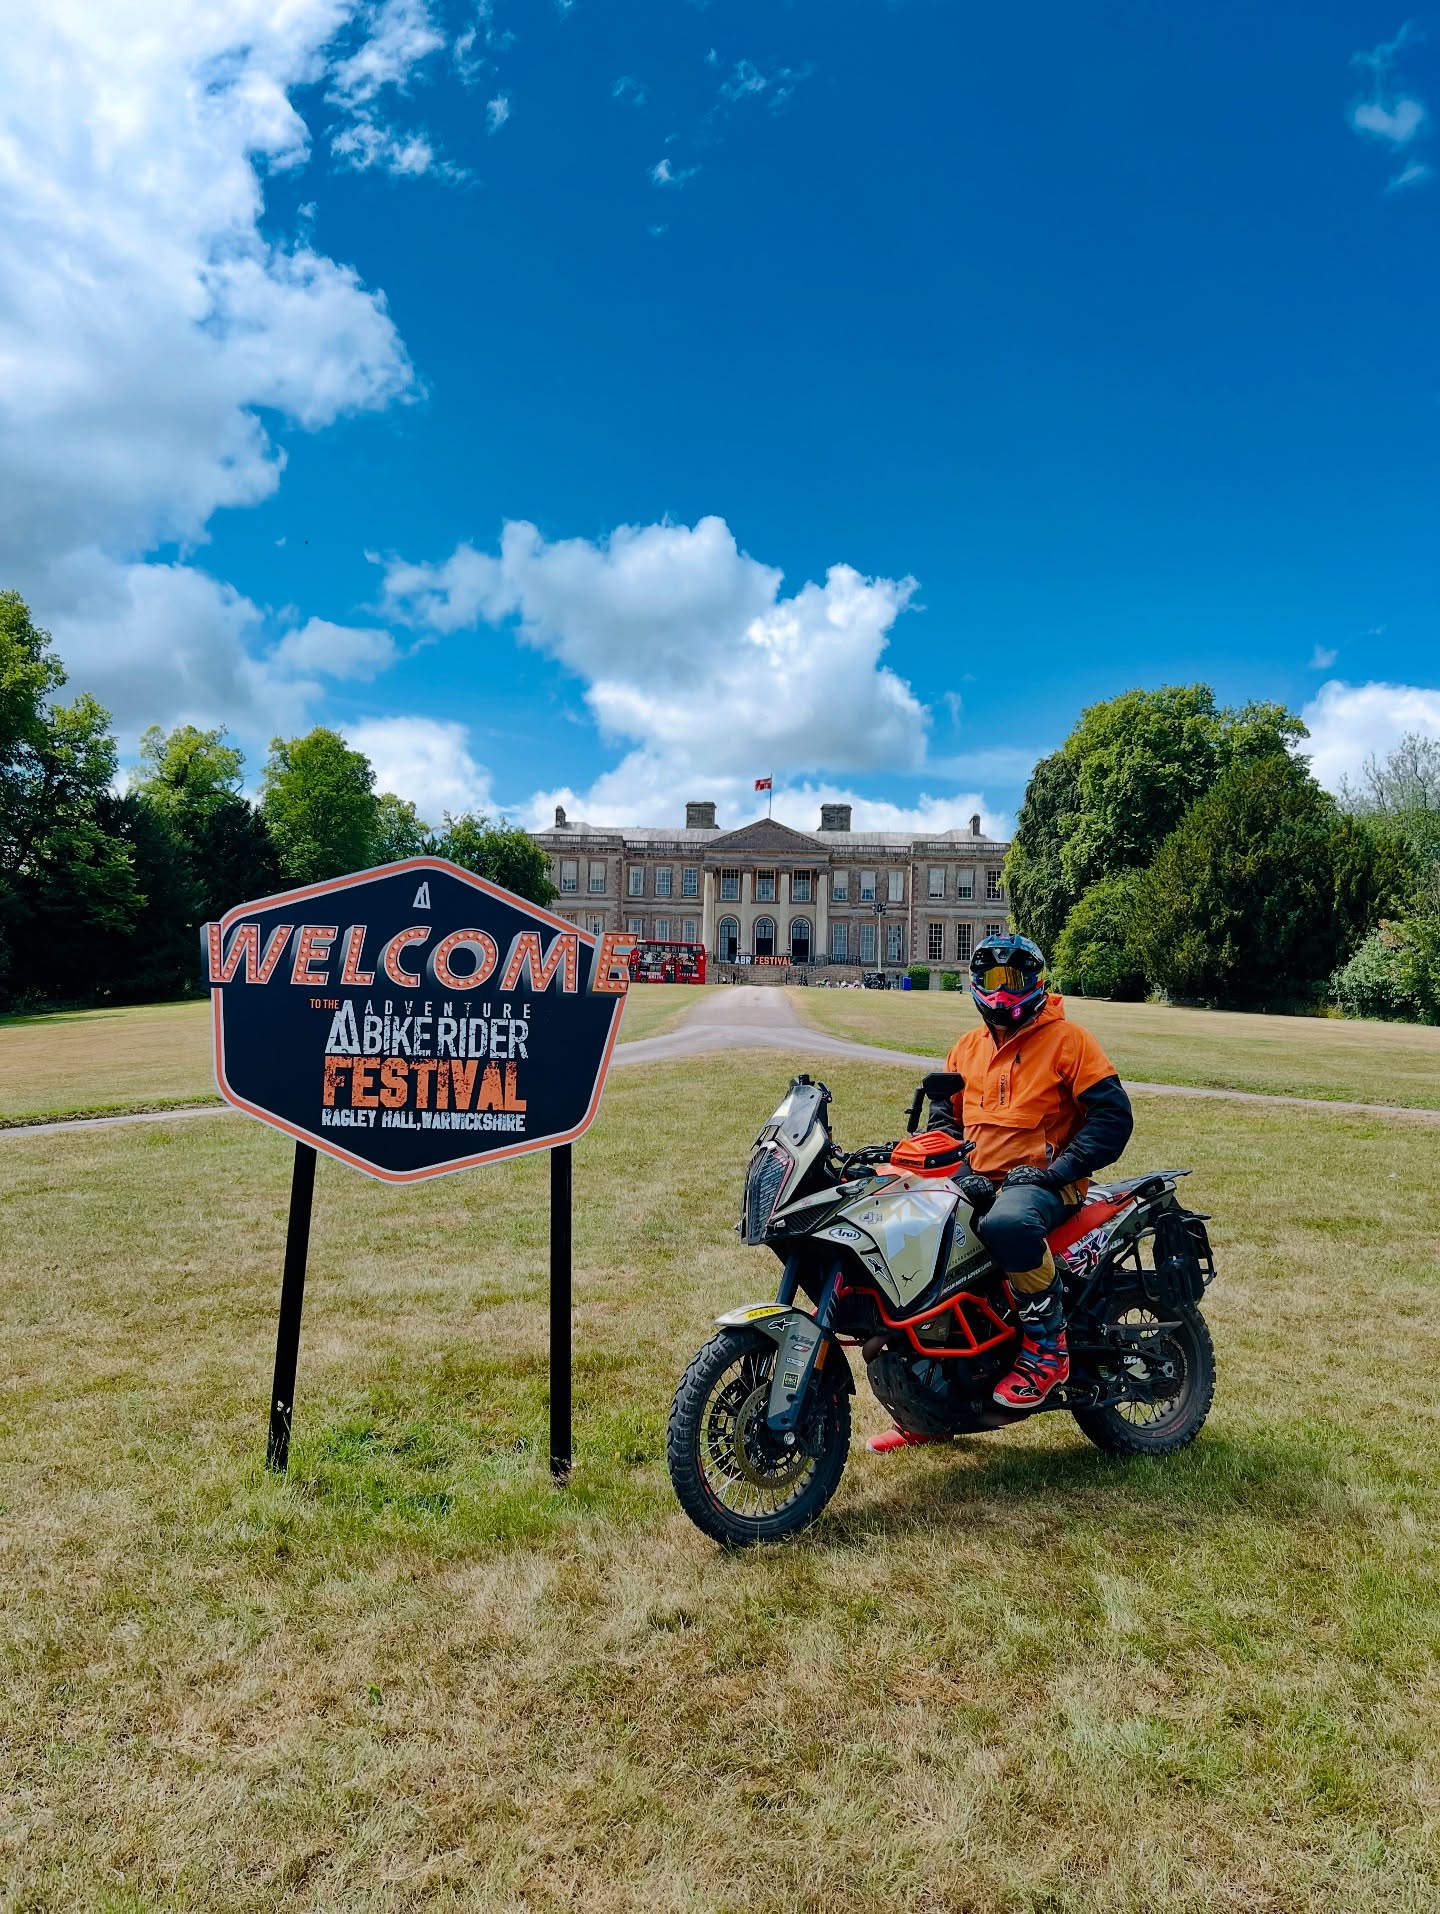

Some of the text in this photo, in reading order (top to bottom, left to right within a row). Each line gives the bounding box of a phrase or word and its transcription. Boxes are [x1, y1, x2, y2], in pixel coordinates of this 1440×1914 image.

[201, 922, 637, 994] WELCOME
[735, 956, 793, 965] ABR FESTIVAL
[310, 999, 339, 1009] TO THE
[365, 1000, 531, 1018] ADVENTURE
[363, 1015, 529, 1059] BIKE RIDER
[322, 1056, 527, 1112] FESTIVAL
[322, 1109, 377, 1127] RAGLEY
[836, 1230, 857, 1238] Arai
